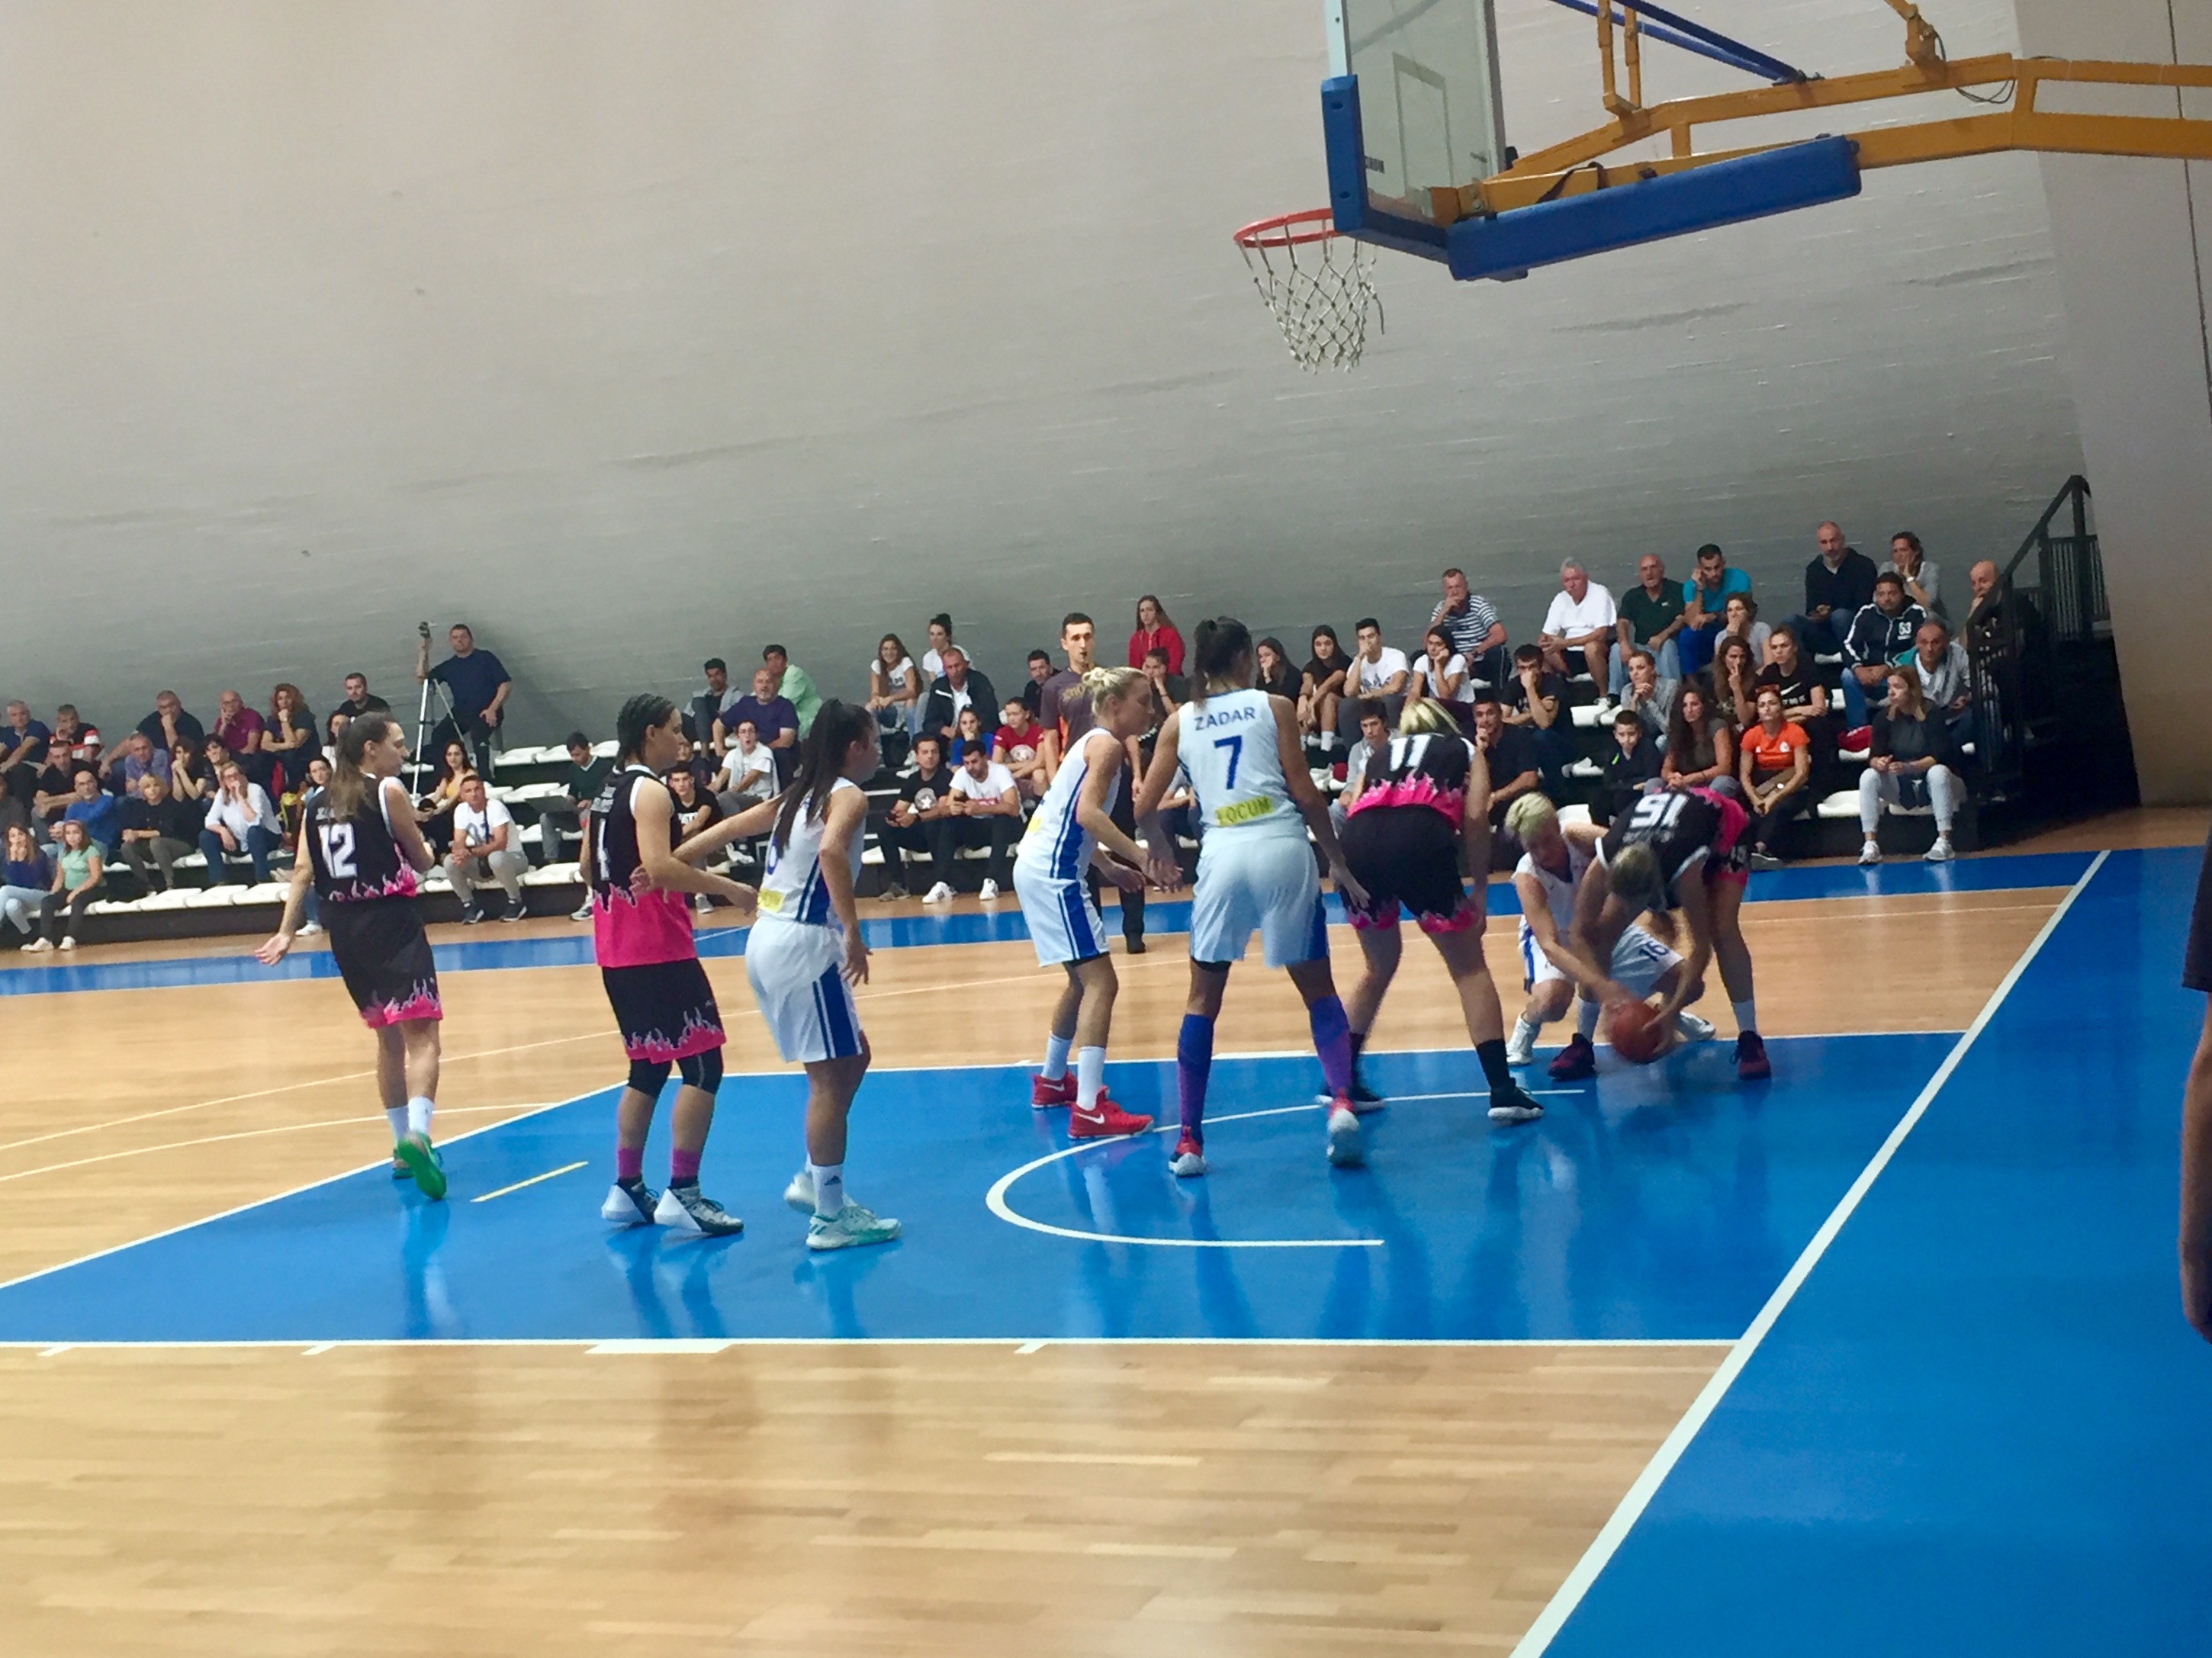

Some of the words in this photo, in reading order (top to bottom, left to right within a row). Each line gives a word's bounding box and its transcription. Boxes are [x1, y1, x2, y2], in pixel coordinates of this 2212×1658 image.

[1194, 706, 1256, 731] ZADAR
[1214, 734, 1243, 789] 7
[1389, 734, 1432, 772] 11
[1630, 792, 1690, 828] 15
[318, 822, 358, 879] 12
[1639, 936, 1670, 962] 16
